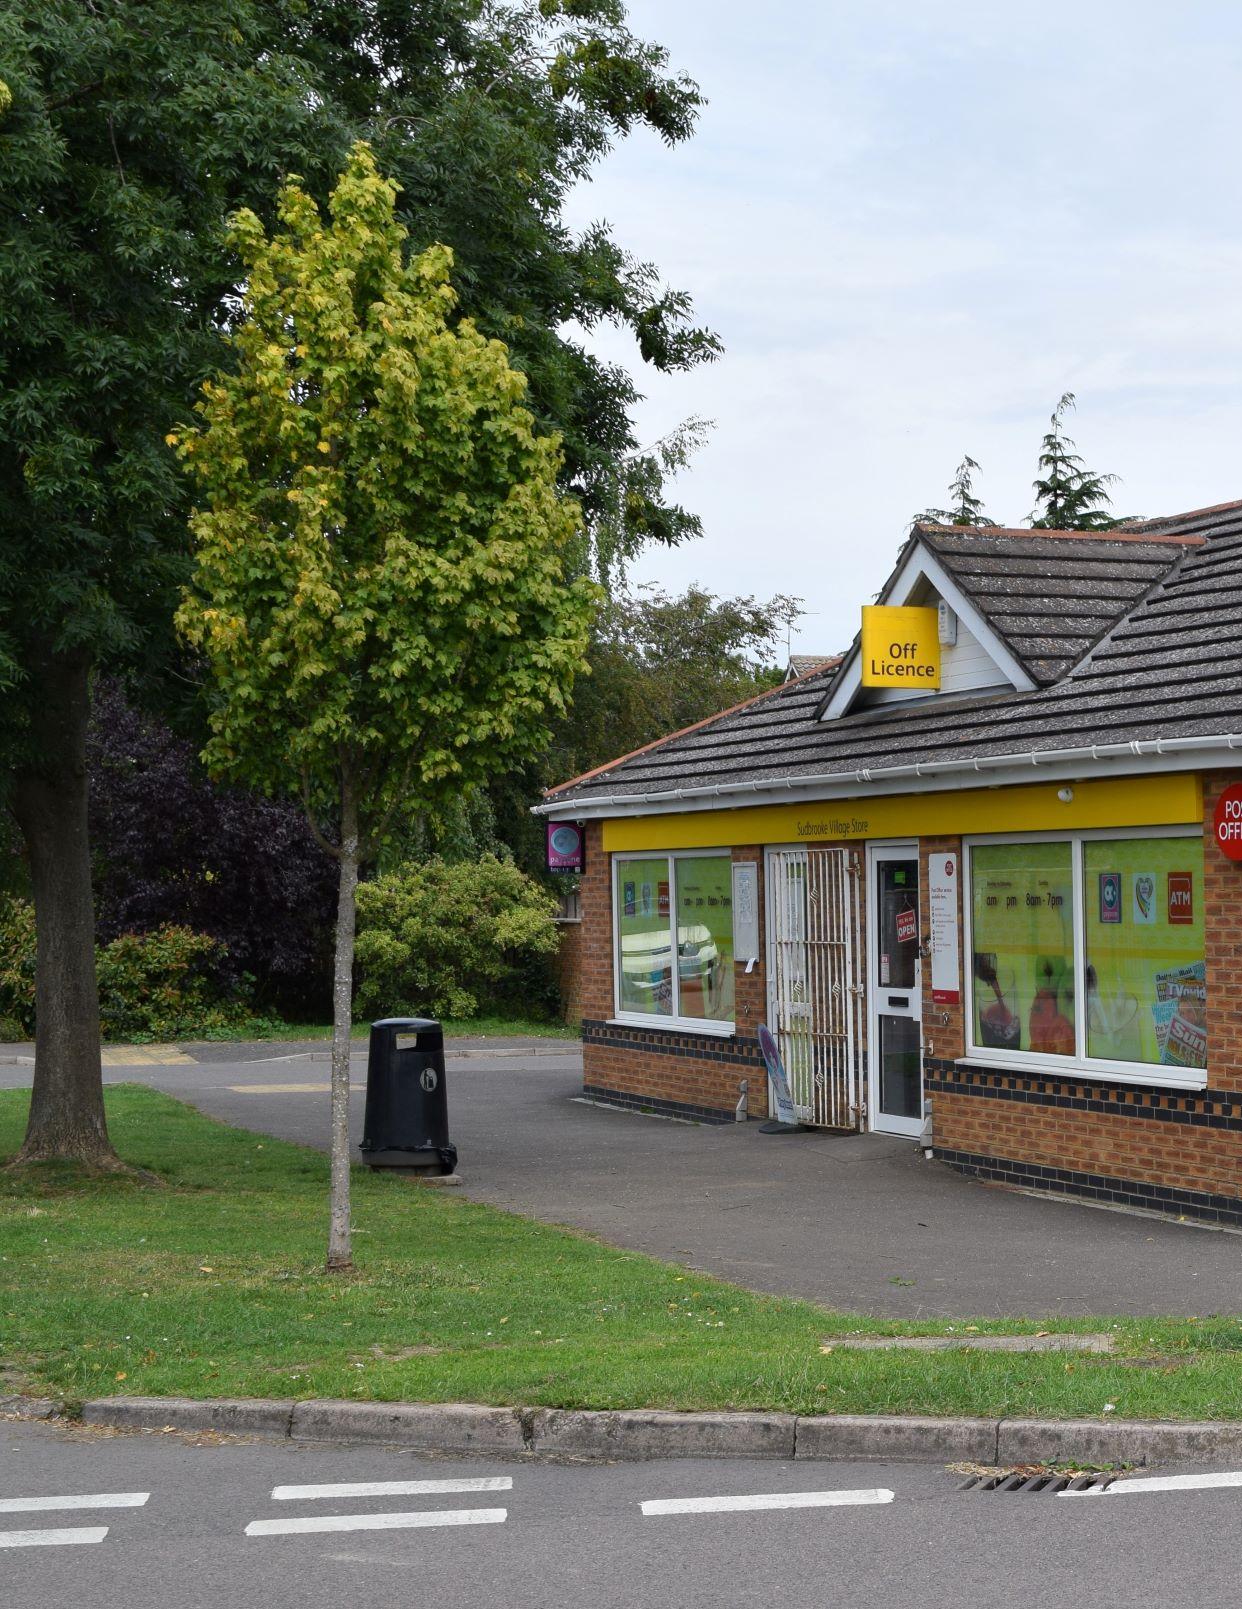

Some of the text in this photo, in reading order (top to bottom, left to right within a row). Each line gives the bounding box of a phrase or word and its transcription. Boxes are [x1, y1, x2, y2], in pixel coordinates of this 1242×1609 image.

[889, 643, 918, 660] Off
[871, 660, 935, 677] Licence
[797, 818, 869, 837] Sudbrooke Village Store
[986, 895, 1017, 909] am pm
[1025, 892, 1041, 906] 8am
[1046, 892, 1063, 909] 7pm
[1170, 892, 1191, 905] ATM
[898, 924, 915, 937] OPEN
[1172, 1018, 1206, 1052] Sun
